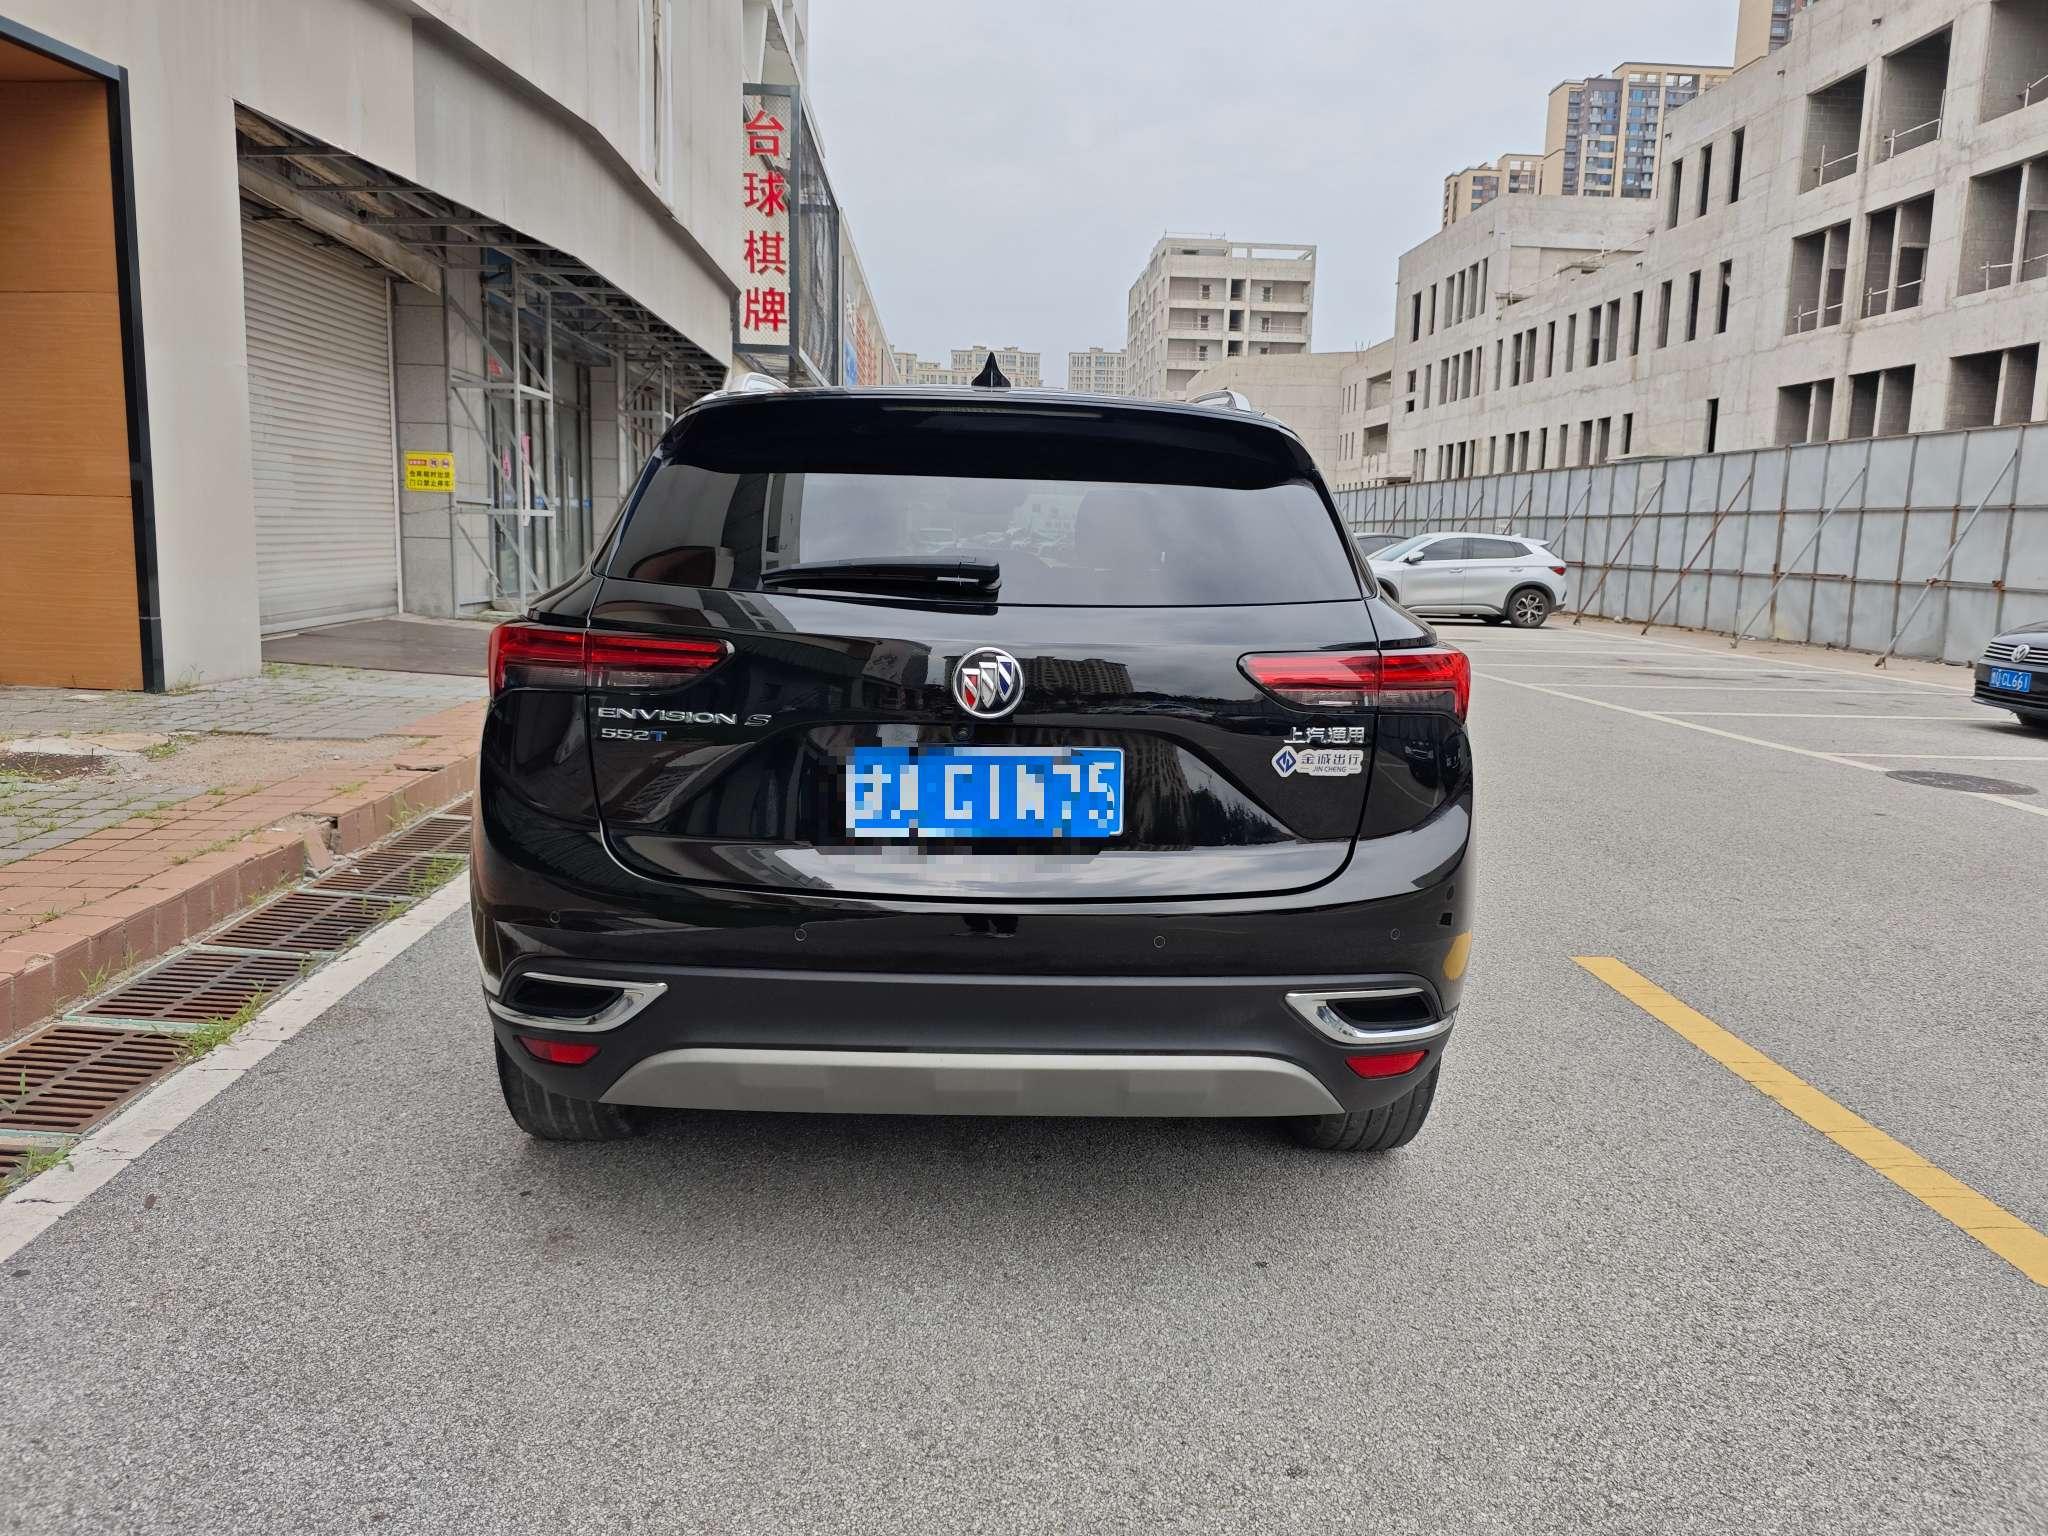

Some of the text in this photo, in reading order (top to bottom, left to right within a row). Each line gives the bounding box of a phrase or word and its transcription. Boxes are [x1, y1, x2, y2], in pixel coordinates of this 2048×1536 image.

[743, 110, 788, 332] 台球棋牌
[598, 707, 772, 726] ENVISION S
[601, 728, 668, 742] 552T
[1283, 726, 1365, 744] 上汽通用
[1300, 753, 1361, 765] 金诚出行
